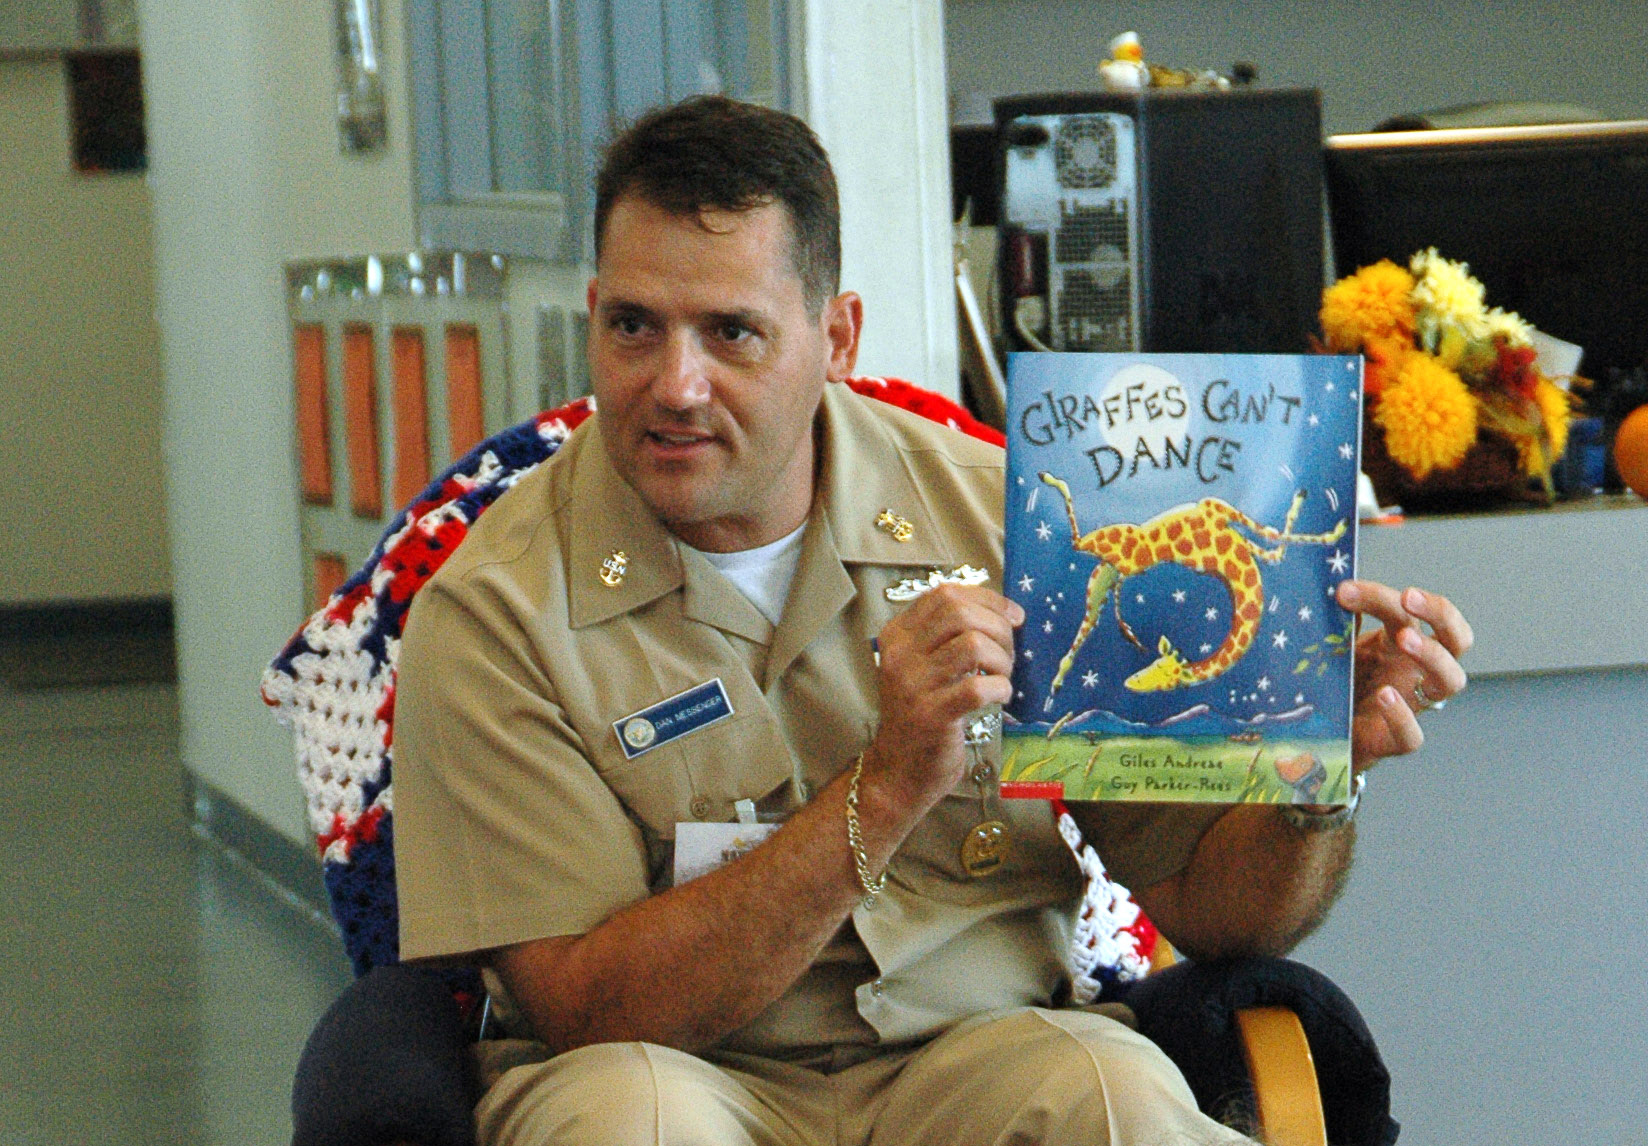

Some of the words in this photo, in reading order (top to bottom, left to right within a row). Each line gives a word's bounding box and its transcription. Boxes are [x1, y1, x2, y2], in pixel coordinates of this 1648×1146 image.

[1020, 382, 1187, 447] GIRAFFES
[1202, 379, 1301, 426] CAN'T
[1084, 435, 1242, 488] DANCE
[1120, 753, 1157, 769] Giles
[1162, 754, 1224, 770] Andreae
[1110, 775, 1138, 795] Guy
[1144, 775, 1232, 792] Parker-Rees
